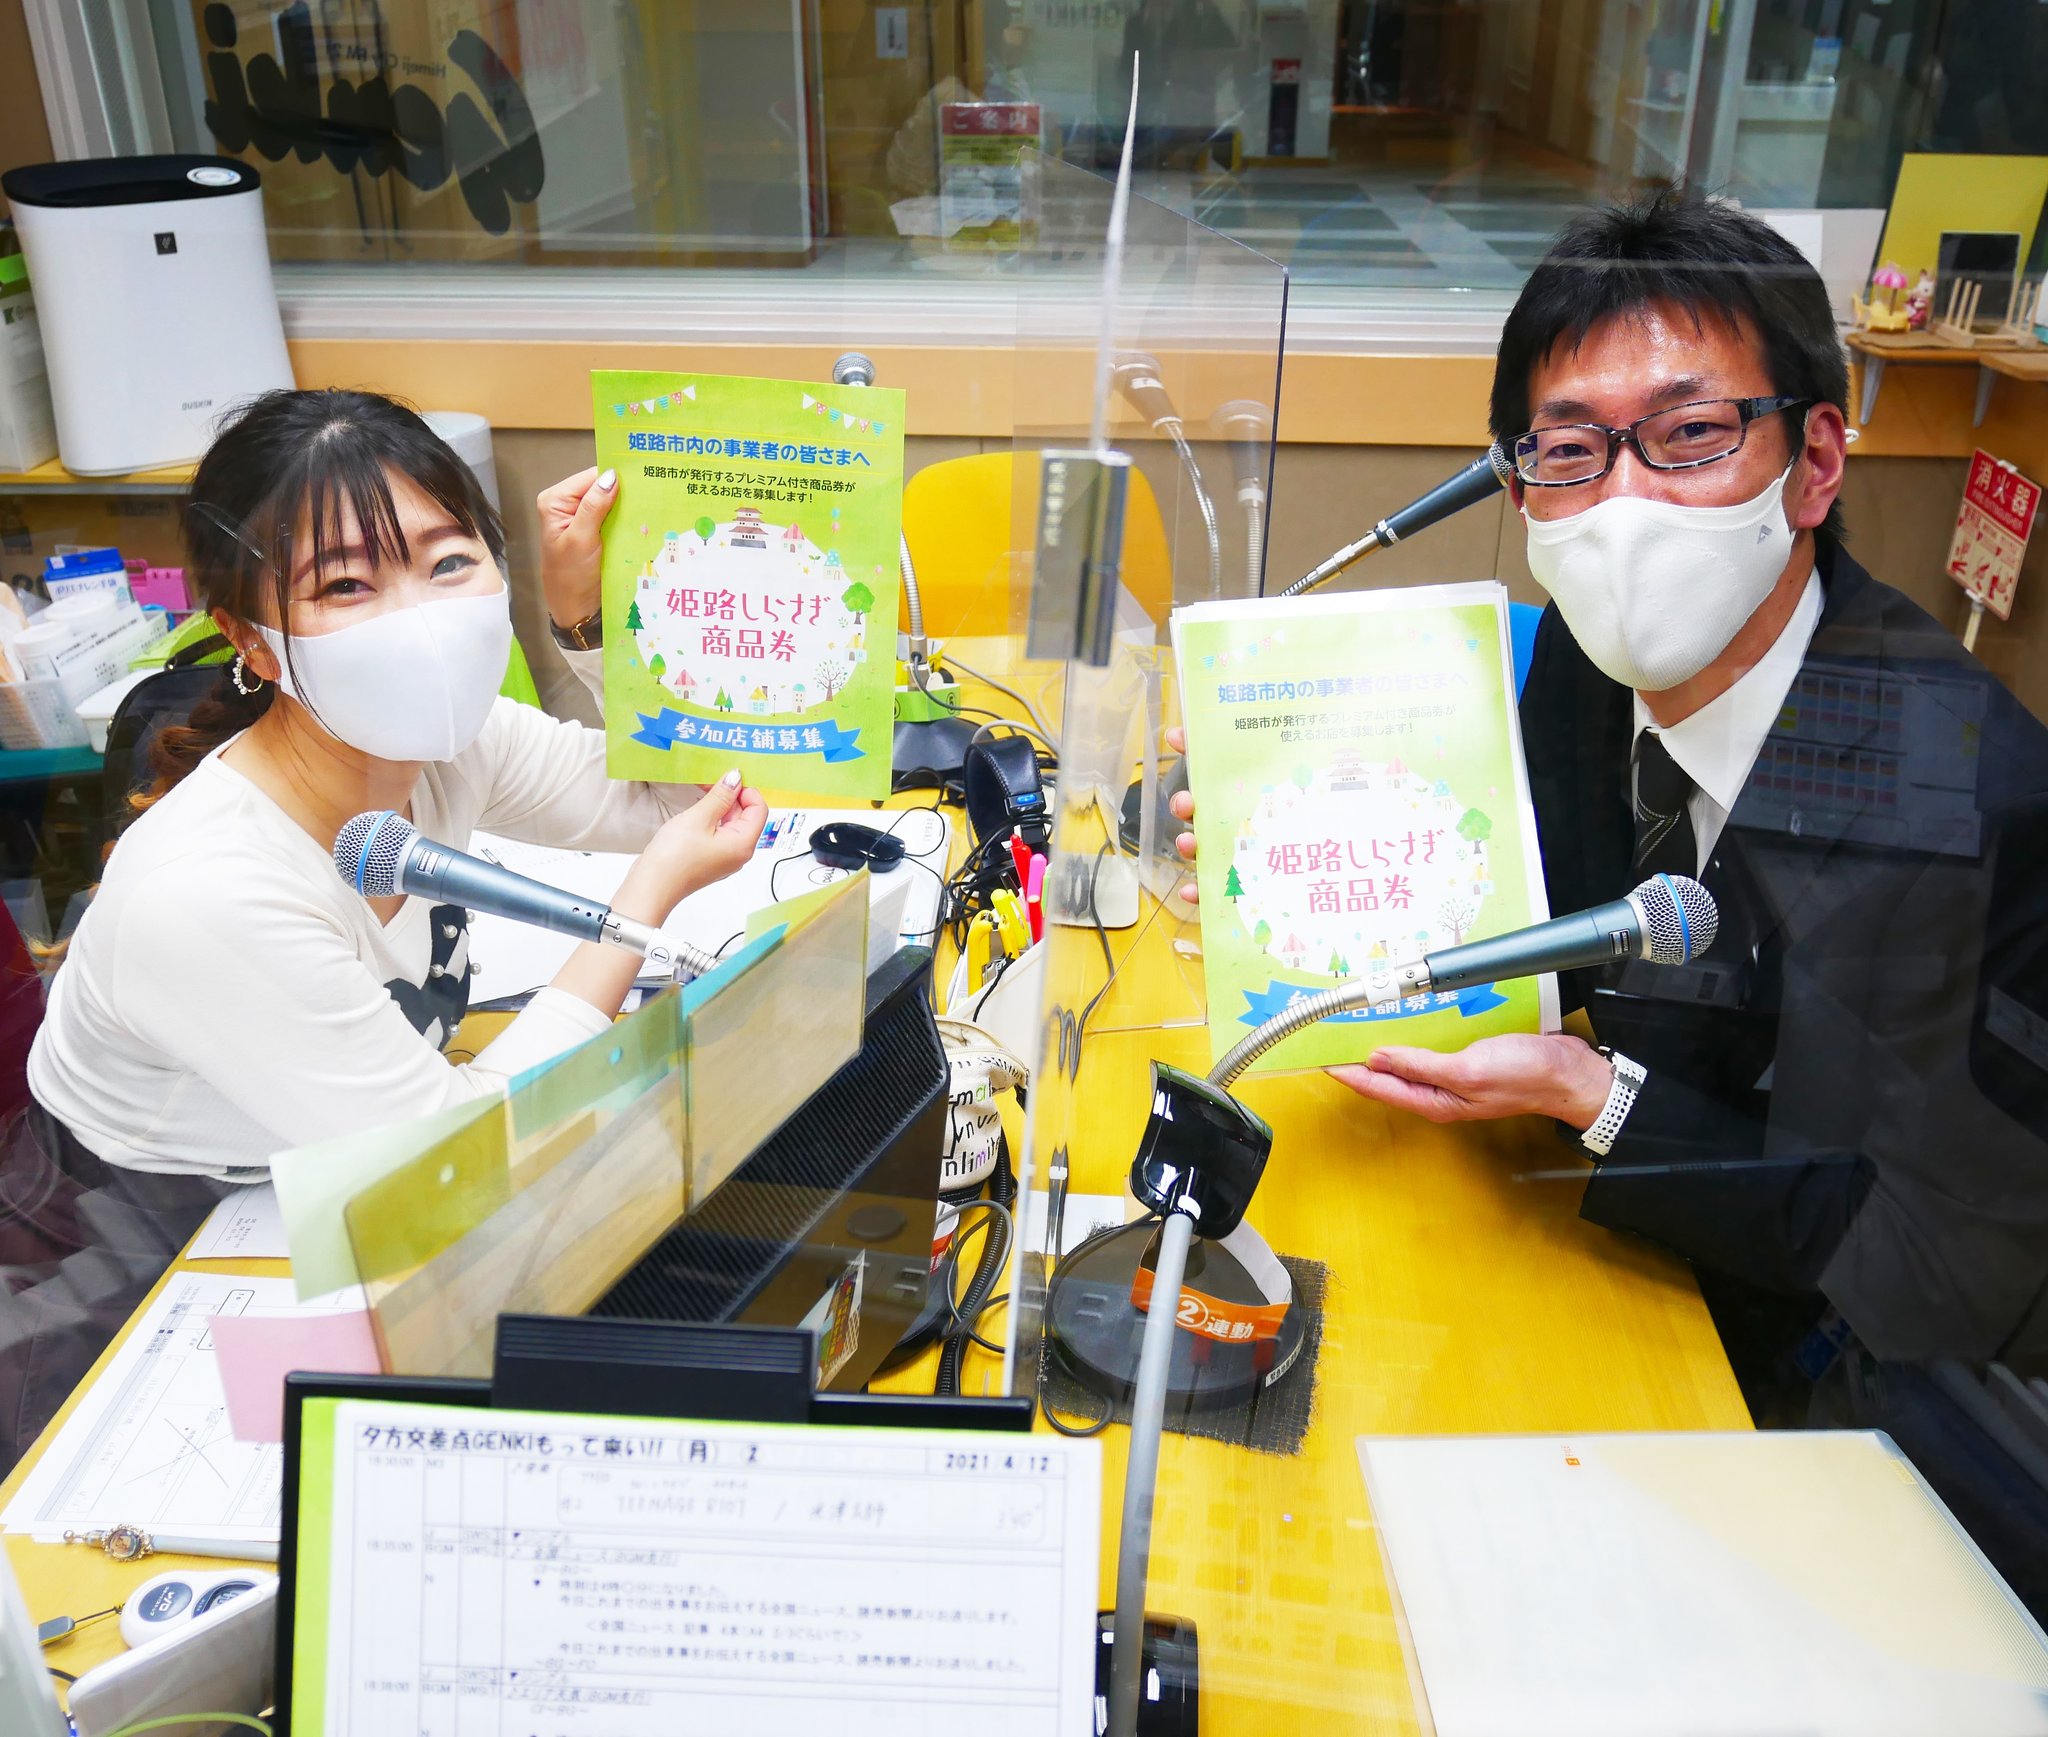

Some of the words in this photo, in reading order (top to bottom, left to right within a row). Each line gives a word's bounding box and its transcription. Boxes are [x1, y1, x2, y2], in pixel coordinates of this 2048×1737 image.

[627, 431, 872, 467] 姫路市内の事業者の皆さまへ
[643, 465, 856, 494] 姫路市が発行するプレミアム付き商品券が
[1974, 460, 2031, 518] 消火器
[666, 587, 831, 626] 姫路しらさぎ
[701, 624, 798, 663] 商品券
[1217, 671, 1470, 705] 姫路市内の事業者の皆さまへ
[674, 718, 825, 751] 参加店舗募集
[1233, 703, 1457, 731] 姫路市が発行するプレミアム付き商品券が
[1266, 828, 1446, 876] 姫路しらさぎ
[1306, 872, 1416, 915] 商品券
